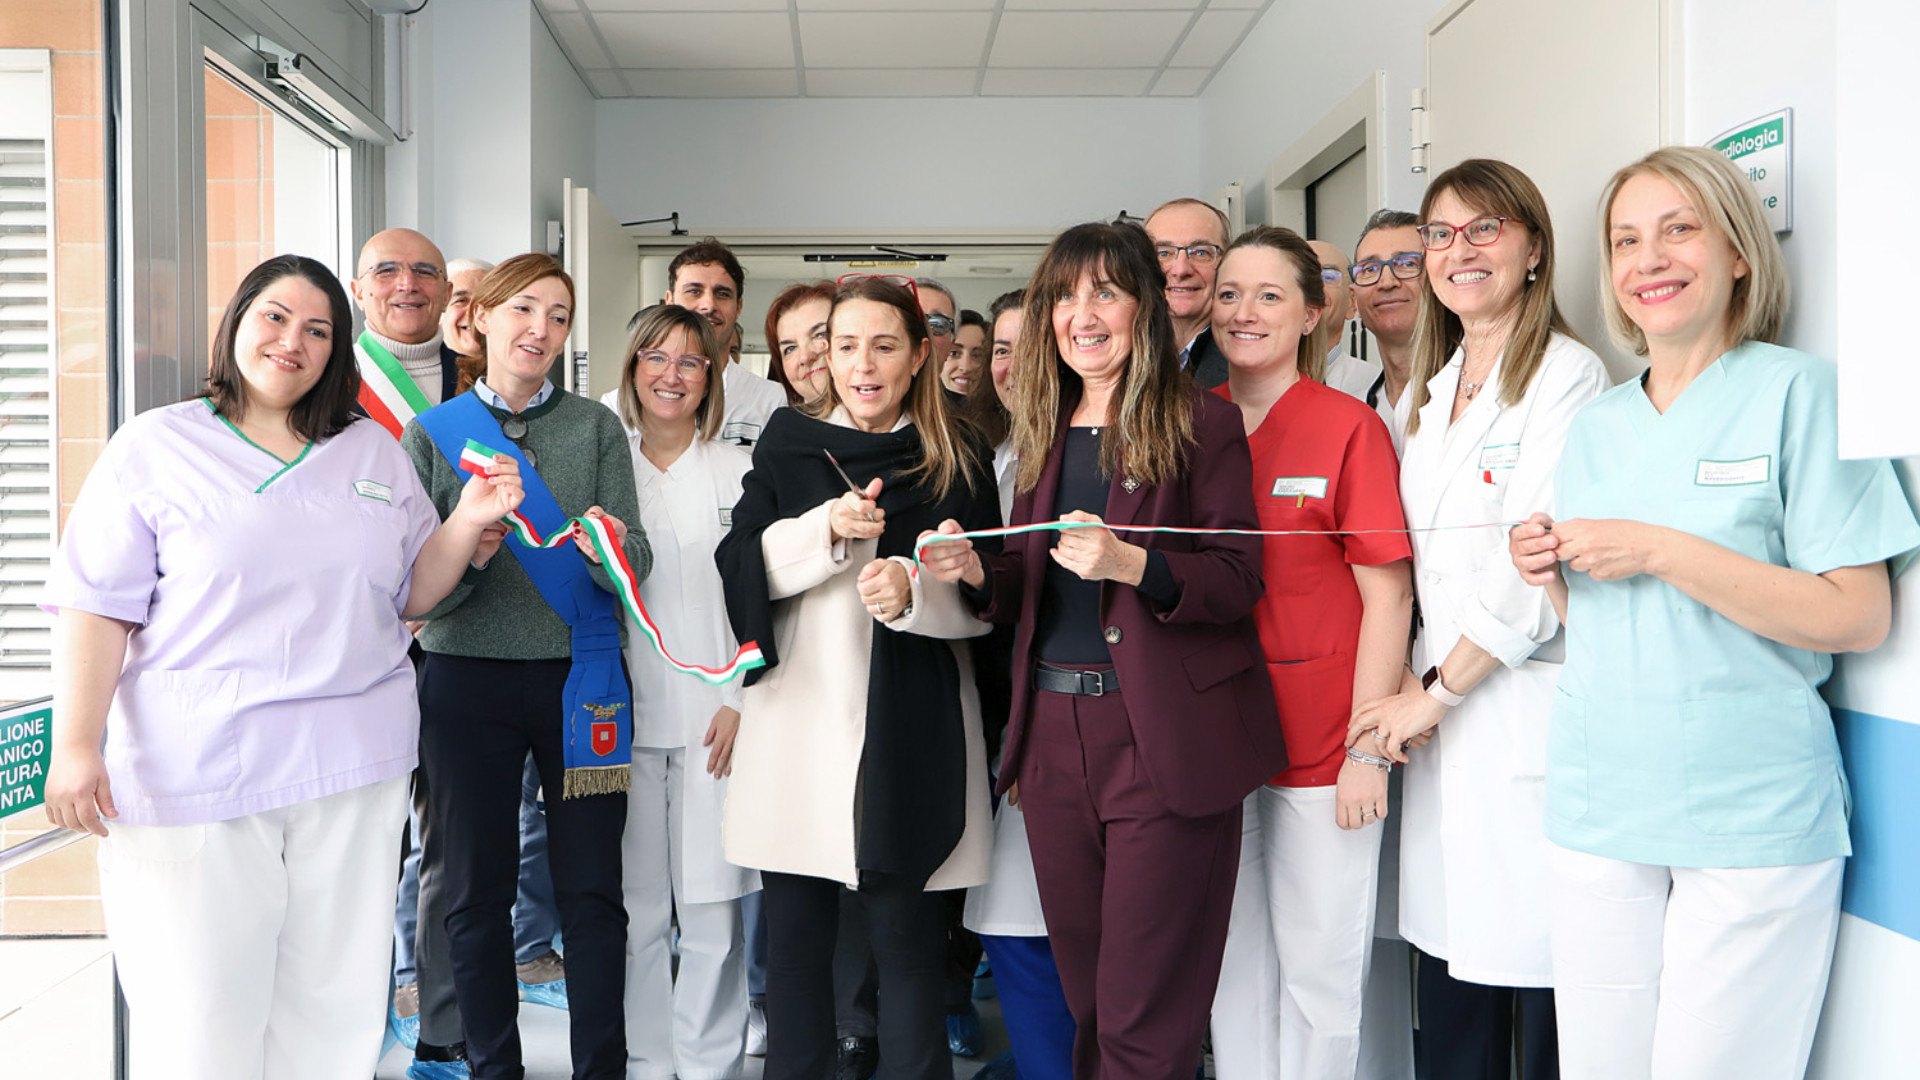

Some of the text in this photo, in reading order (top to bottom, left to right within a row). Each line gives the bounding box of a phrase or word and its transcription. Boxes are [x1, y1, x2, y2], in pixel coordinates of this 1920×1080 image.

[1720, 128, 1778, 158] rdiologia
[1746, 166, 1767, 182] ito
[0, 717, 45, 745] LIONE
[0, 784, 36, 810] NTA
